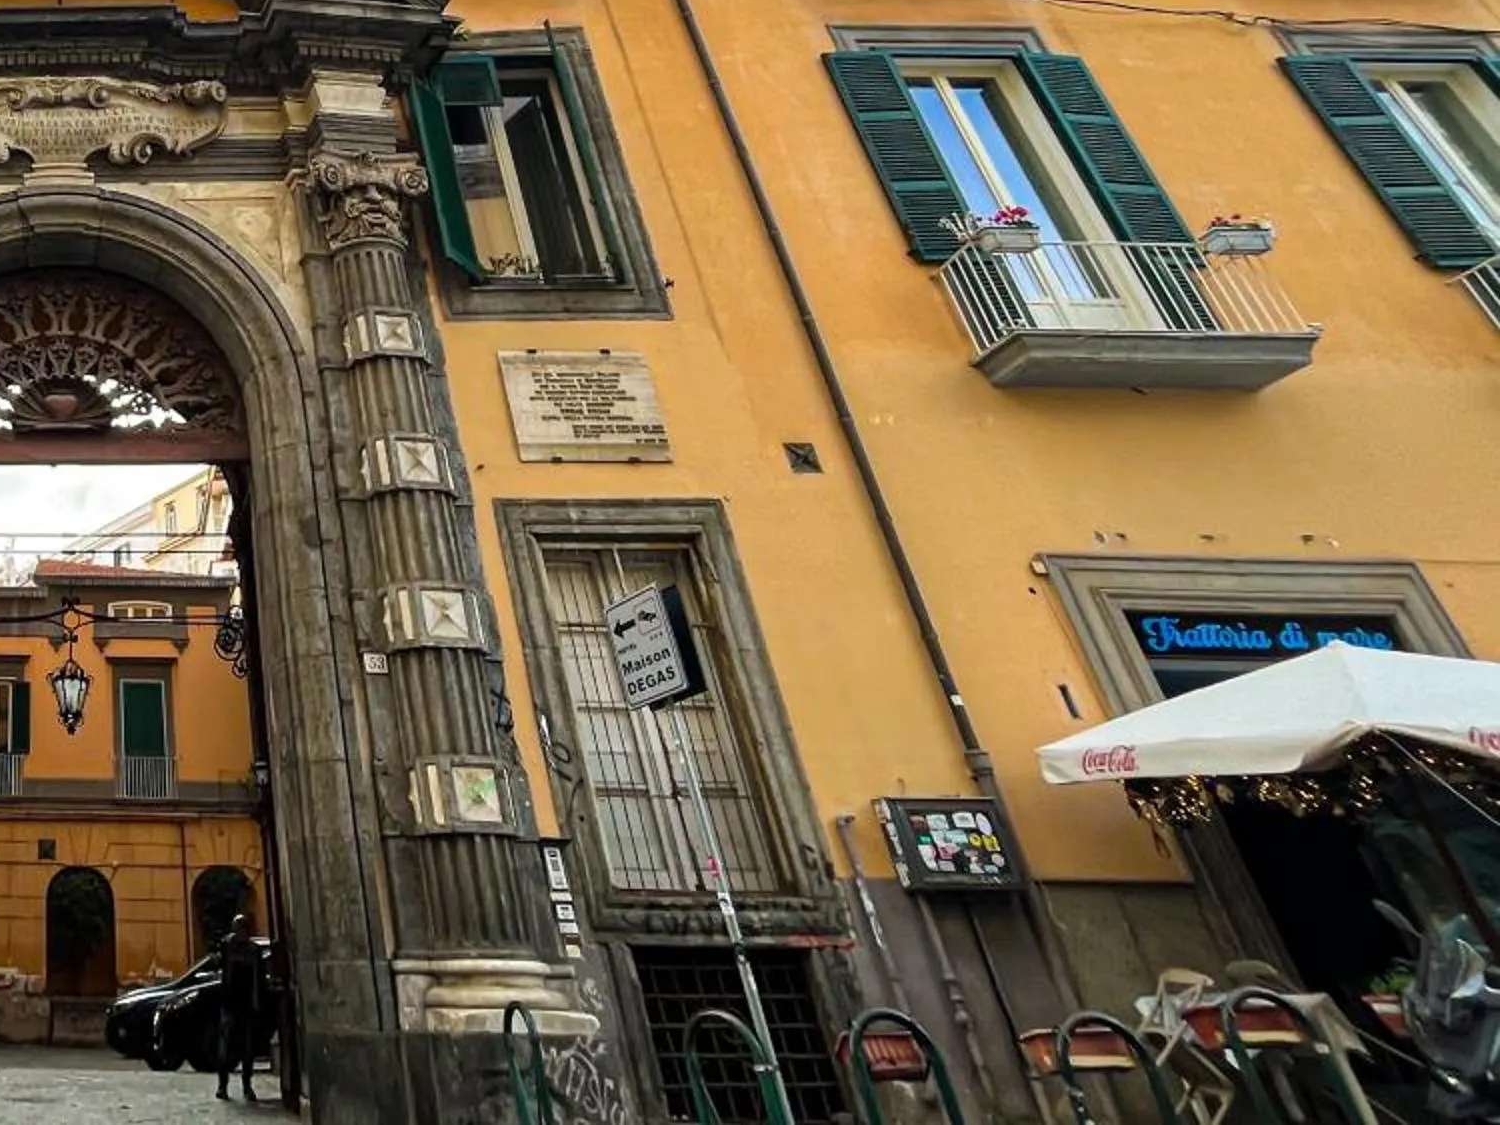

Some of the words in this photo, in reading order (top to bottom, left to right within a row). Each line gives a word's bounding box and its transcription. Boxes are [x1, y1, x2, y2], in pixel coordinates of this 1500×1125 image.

[1141, 616, 1273, 651] Trattoria
[1279, 621, 1309, 650] di
[622, 648, 671, 676] Maison
[627, 666, 676, 696] DEGAS
